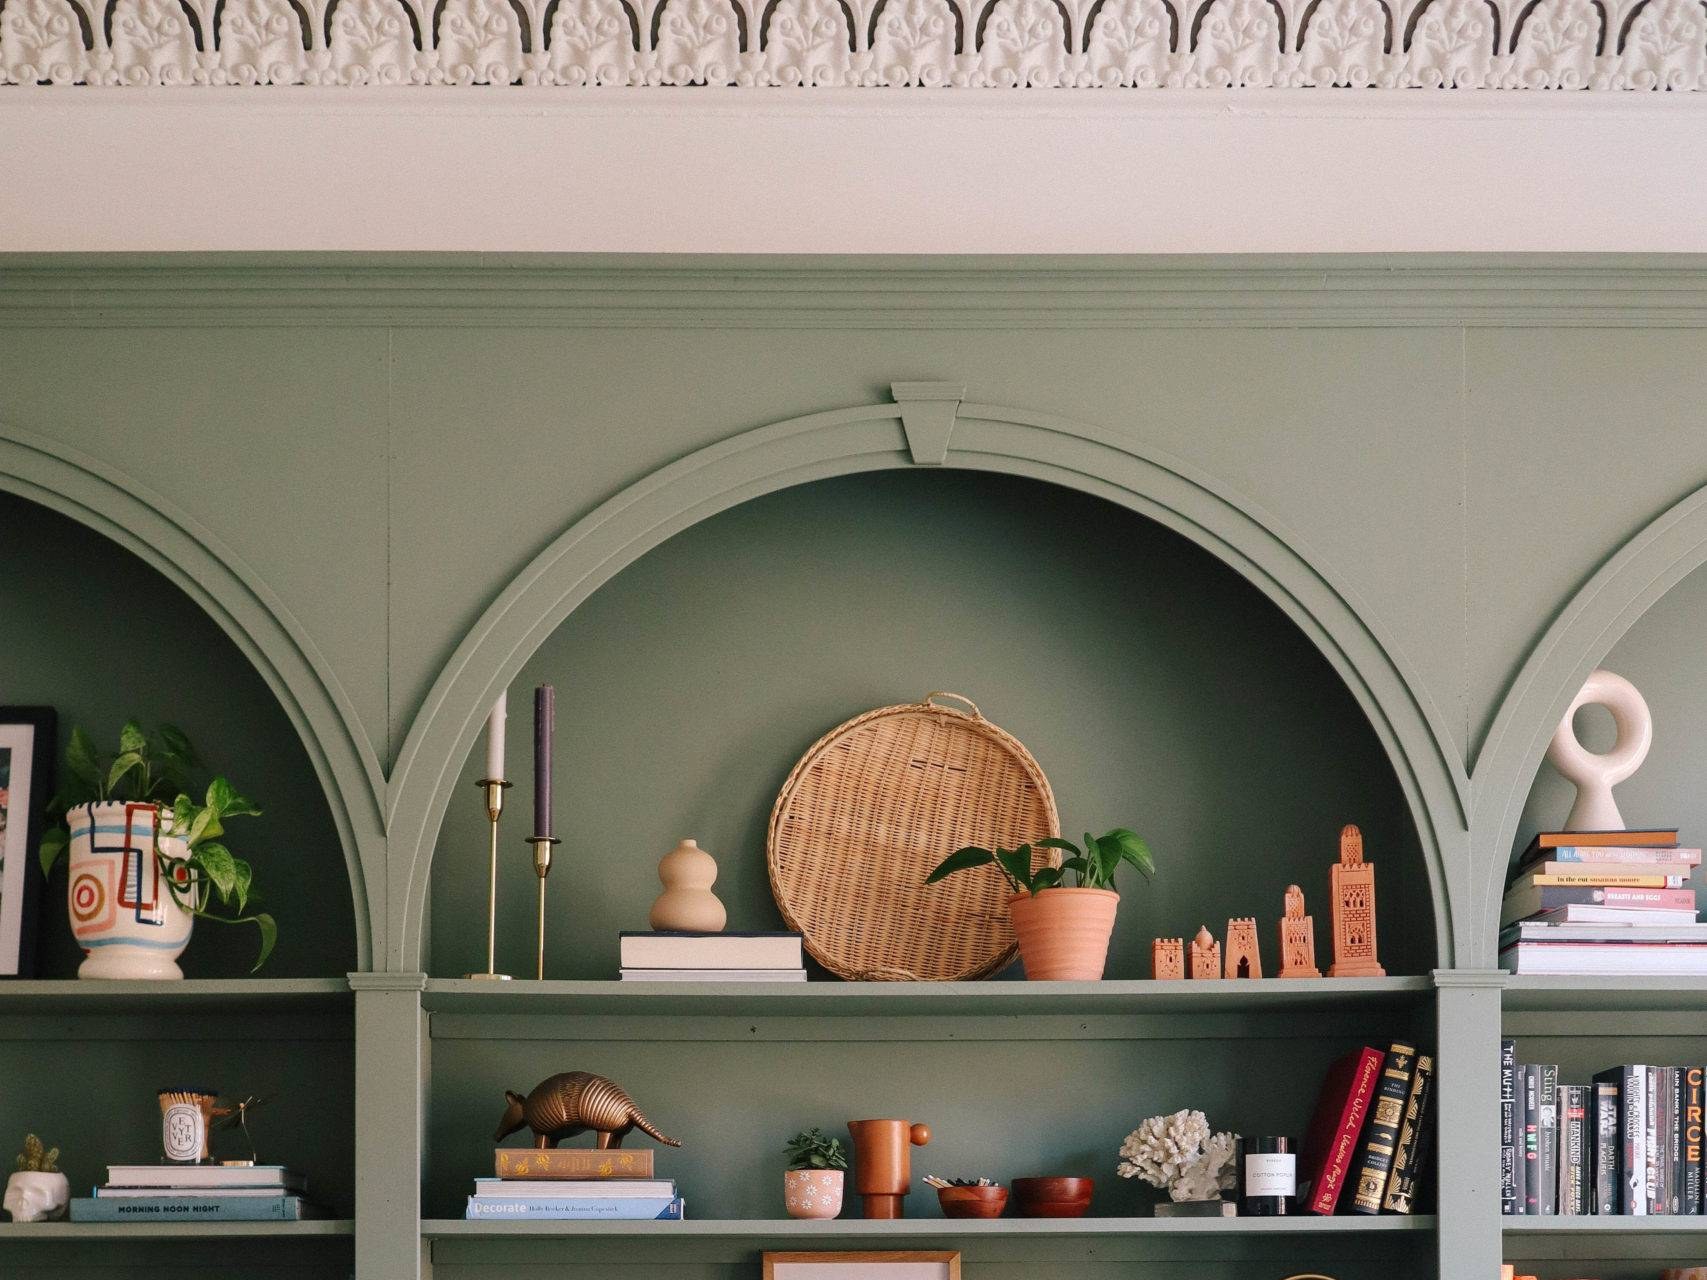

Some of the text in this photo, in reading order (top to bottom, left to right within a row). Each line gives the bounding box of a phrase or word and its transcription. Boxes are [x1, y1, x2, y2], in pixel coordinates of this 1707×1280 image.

[1503, 1046, 1513, 1066] THE
[1384, 1086, 1405, 1095] BINDING
[1540, 1069, 1555, 1101] Sting
[1327, 1056, 1377, 1189] Florence Welch Useless Magic
[1600, 1101, 1608, 1137] WARS
[1608, 1104, 1616, 1136] STAR
[1687, 1069, 1702, 1162] CIRCE
[1571, 1121, 1581, 1164] MANKIND
[1647, 1167, 1656, 1199] CLUB
[475, 1203, 527, 1213] Decorate
